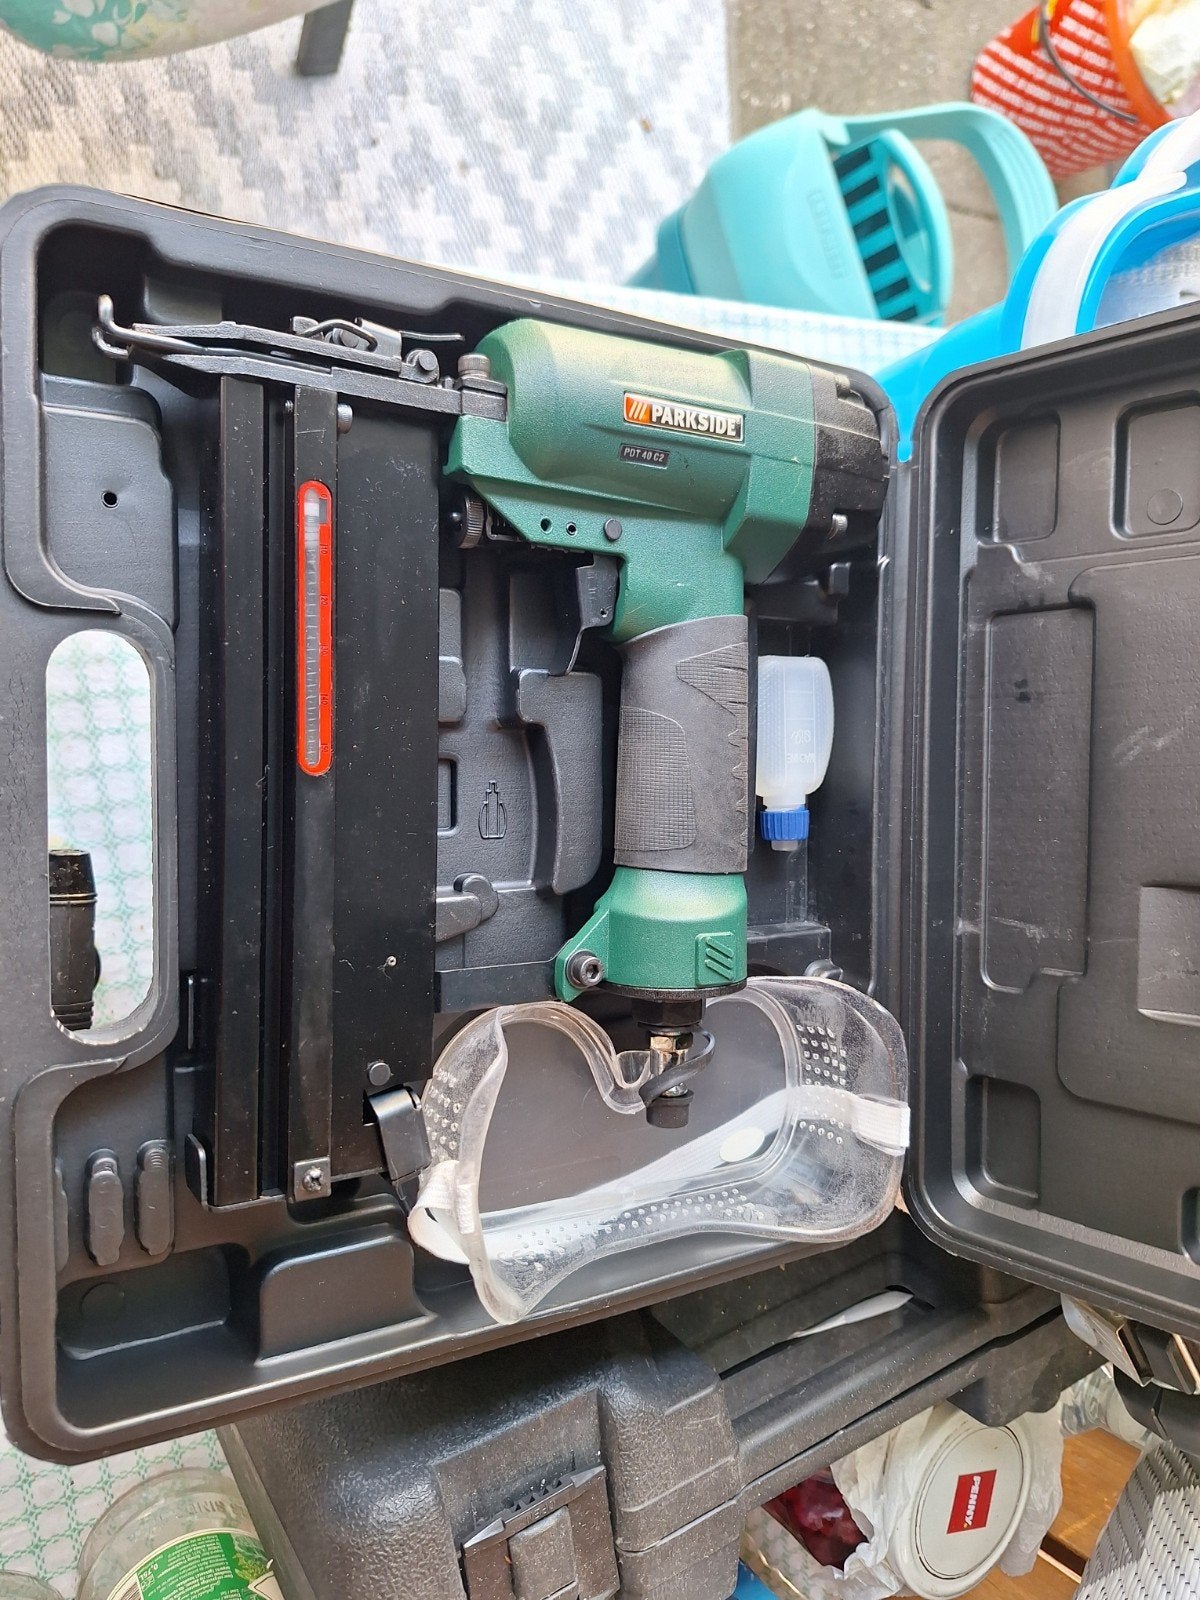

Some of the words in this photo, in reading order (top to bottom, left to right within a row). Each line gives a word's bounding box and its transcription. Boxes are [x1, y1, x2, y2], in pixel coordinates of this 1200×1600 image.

[651, 403, 737, 437] PARKSIDE
[623, 446, 641, 459] PDT
[641, 448, 653, 461] 40
[653, 451, 665, 463] C2
